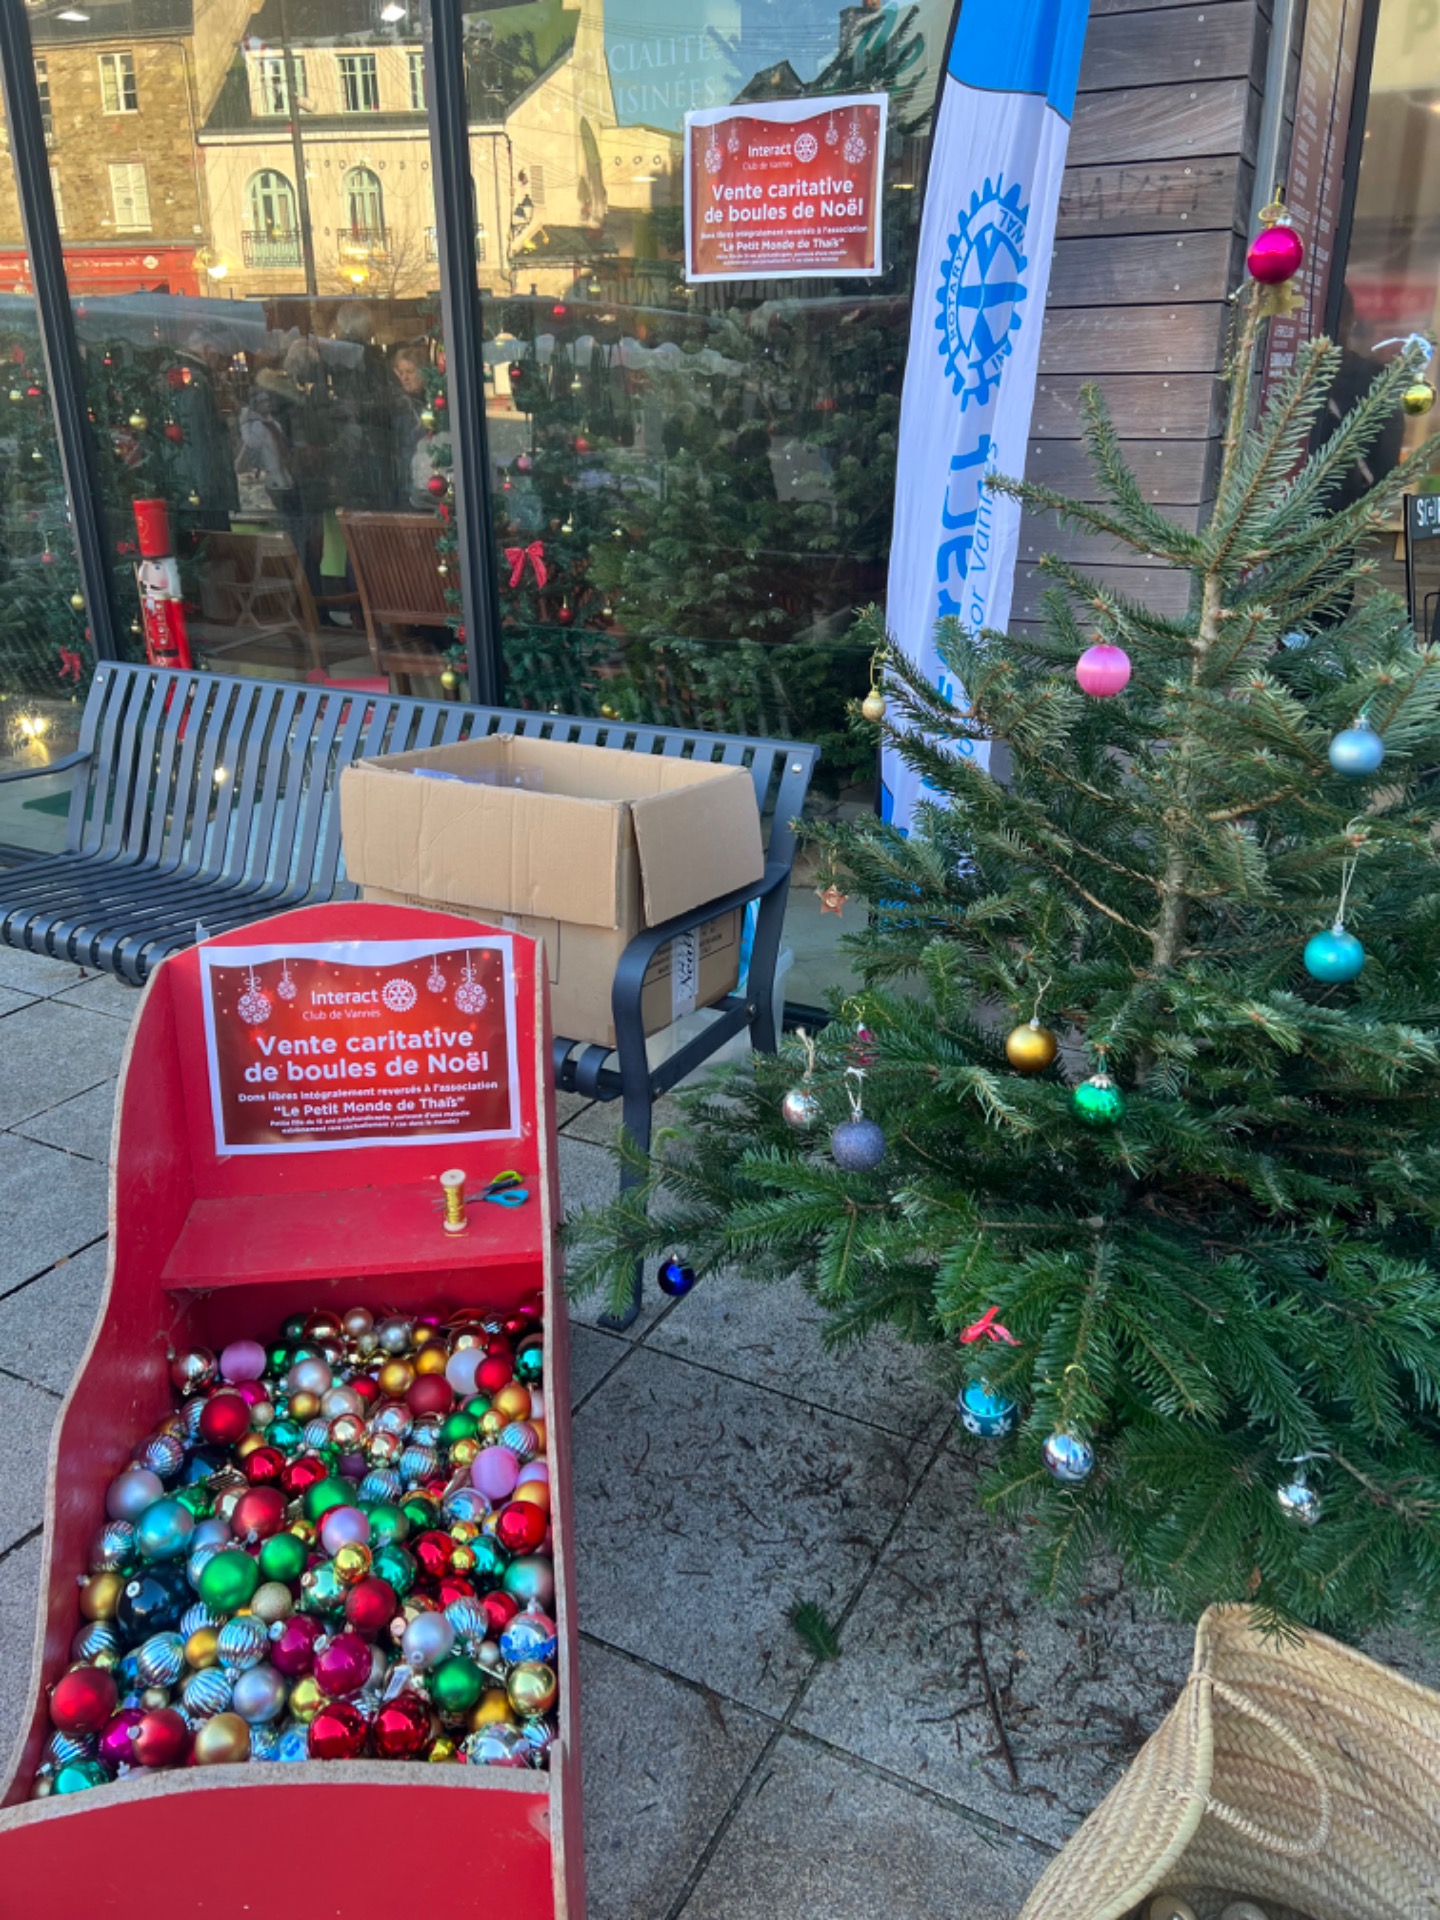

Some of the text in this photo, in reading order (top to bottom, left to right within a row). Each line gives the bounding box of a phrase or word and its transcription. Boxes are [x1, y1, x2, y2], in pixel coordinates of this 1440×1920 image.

[748, 143, 792, 157] Interact
[711, 176, 854, 201] Vente caritative
[704, 198, 864, 224] de boules de Noël
[736, 240, 759, 250] Petit
[761, 239, 795, 250] Monde
[797, 238, 810, 249] de
[948, 251, 964, 342] ROTARY
[311, 988, 379, 1006] Interact
[302, 1008, 381, 1021] Club de Vannes
[256, 1028, 473, 1056] Vente caritative
[244, 1051, 489, 1083] de boules de Noël
[237, 1093, 266, 1102] Dons
[268, 1091, 298, 1100] libres
[424, 1083, 431, 1093] à
[303, 1102, 339, 1115] Petit
[343, 1099, 392, 1113] Monde
[396, 1098, 415, 1111] de
